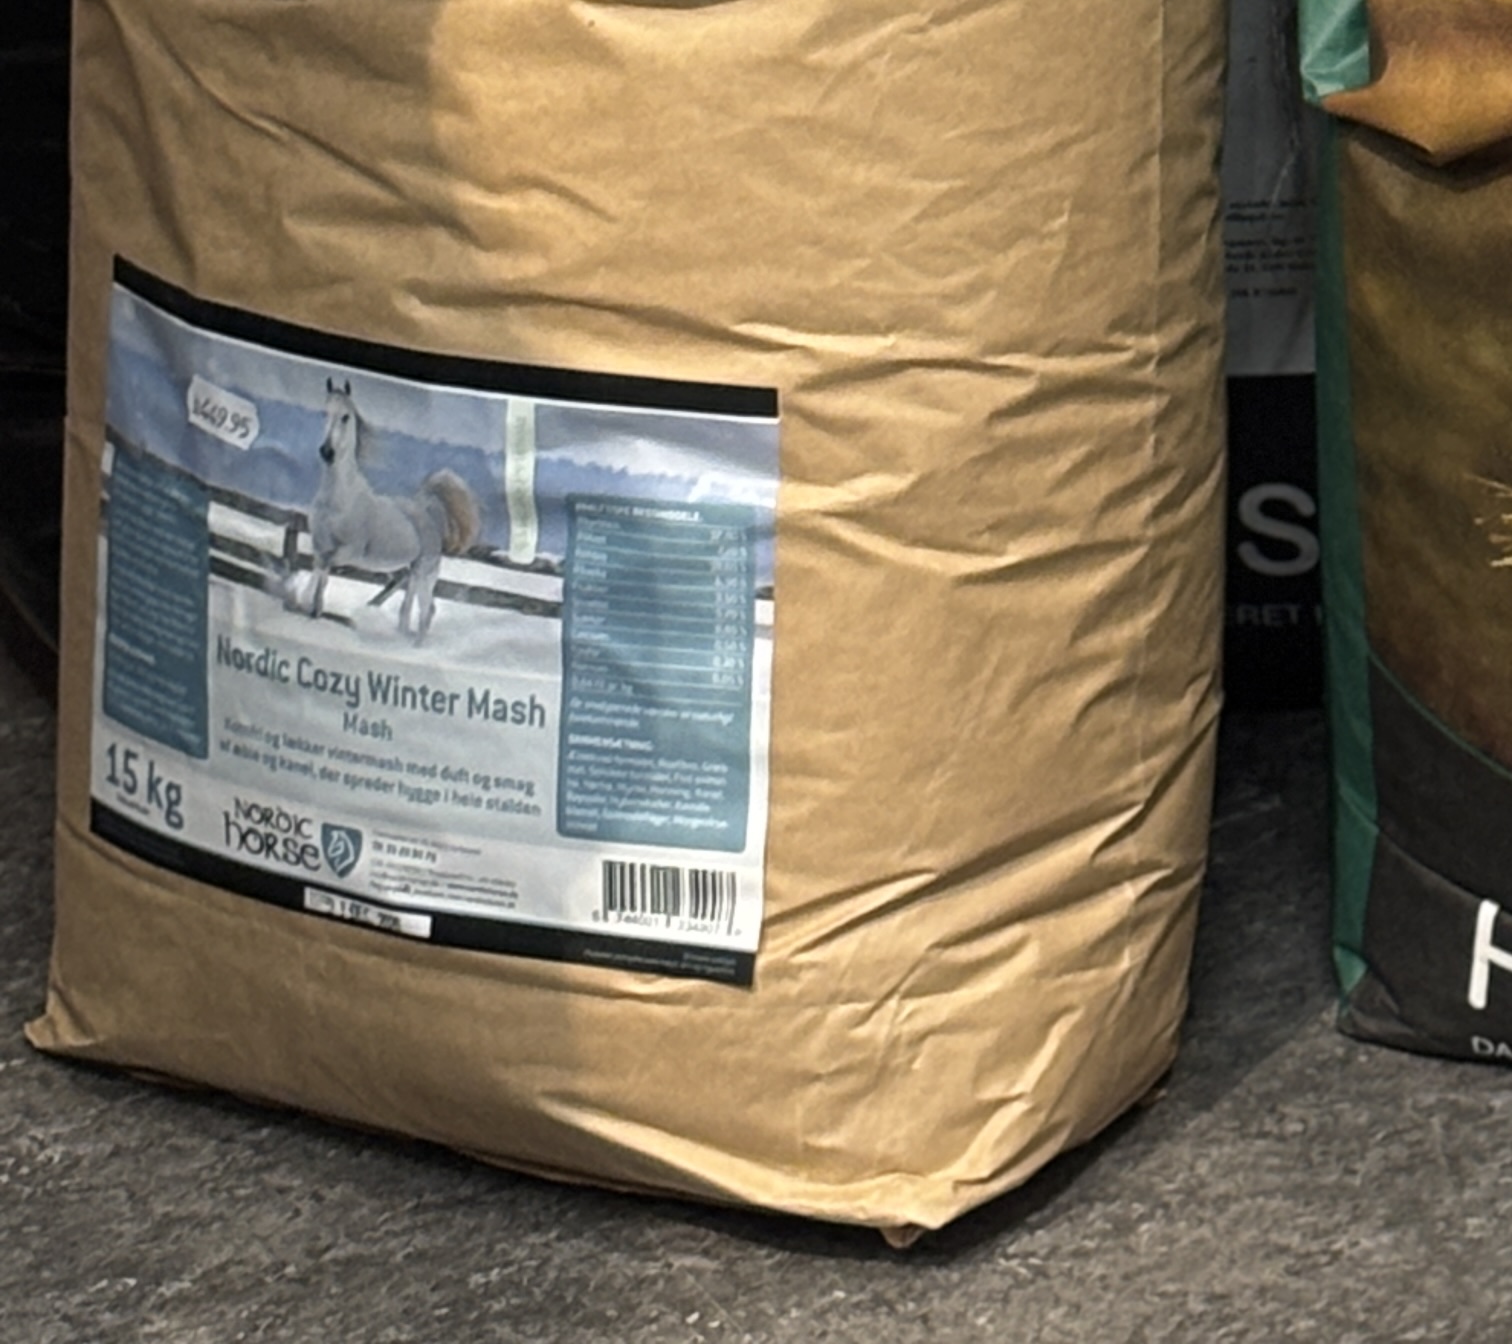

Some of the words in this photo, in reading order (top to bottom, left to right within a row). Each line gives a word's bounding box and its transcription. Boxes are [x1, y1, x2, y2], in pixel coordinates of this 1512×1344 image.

[215, 633, 291, 684] Nordic
[296, 656, 362, 710] Cozy
[366, 669, 461, 716] Winter
[466, 686, 547, 729] Mash
[342, 712, 394, 742] Mash
[105, 742, 140, 797] 15
[146, 759, 185, 831] kg
